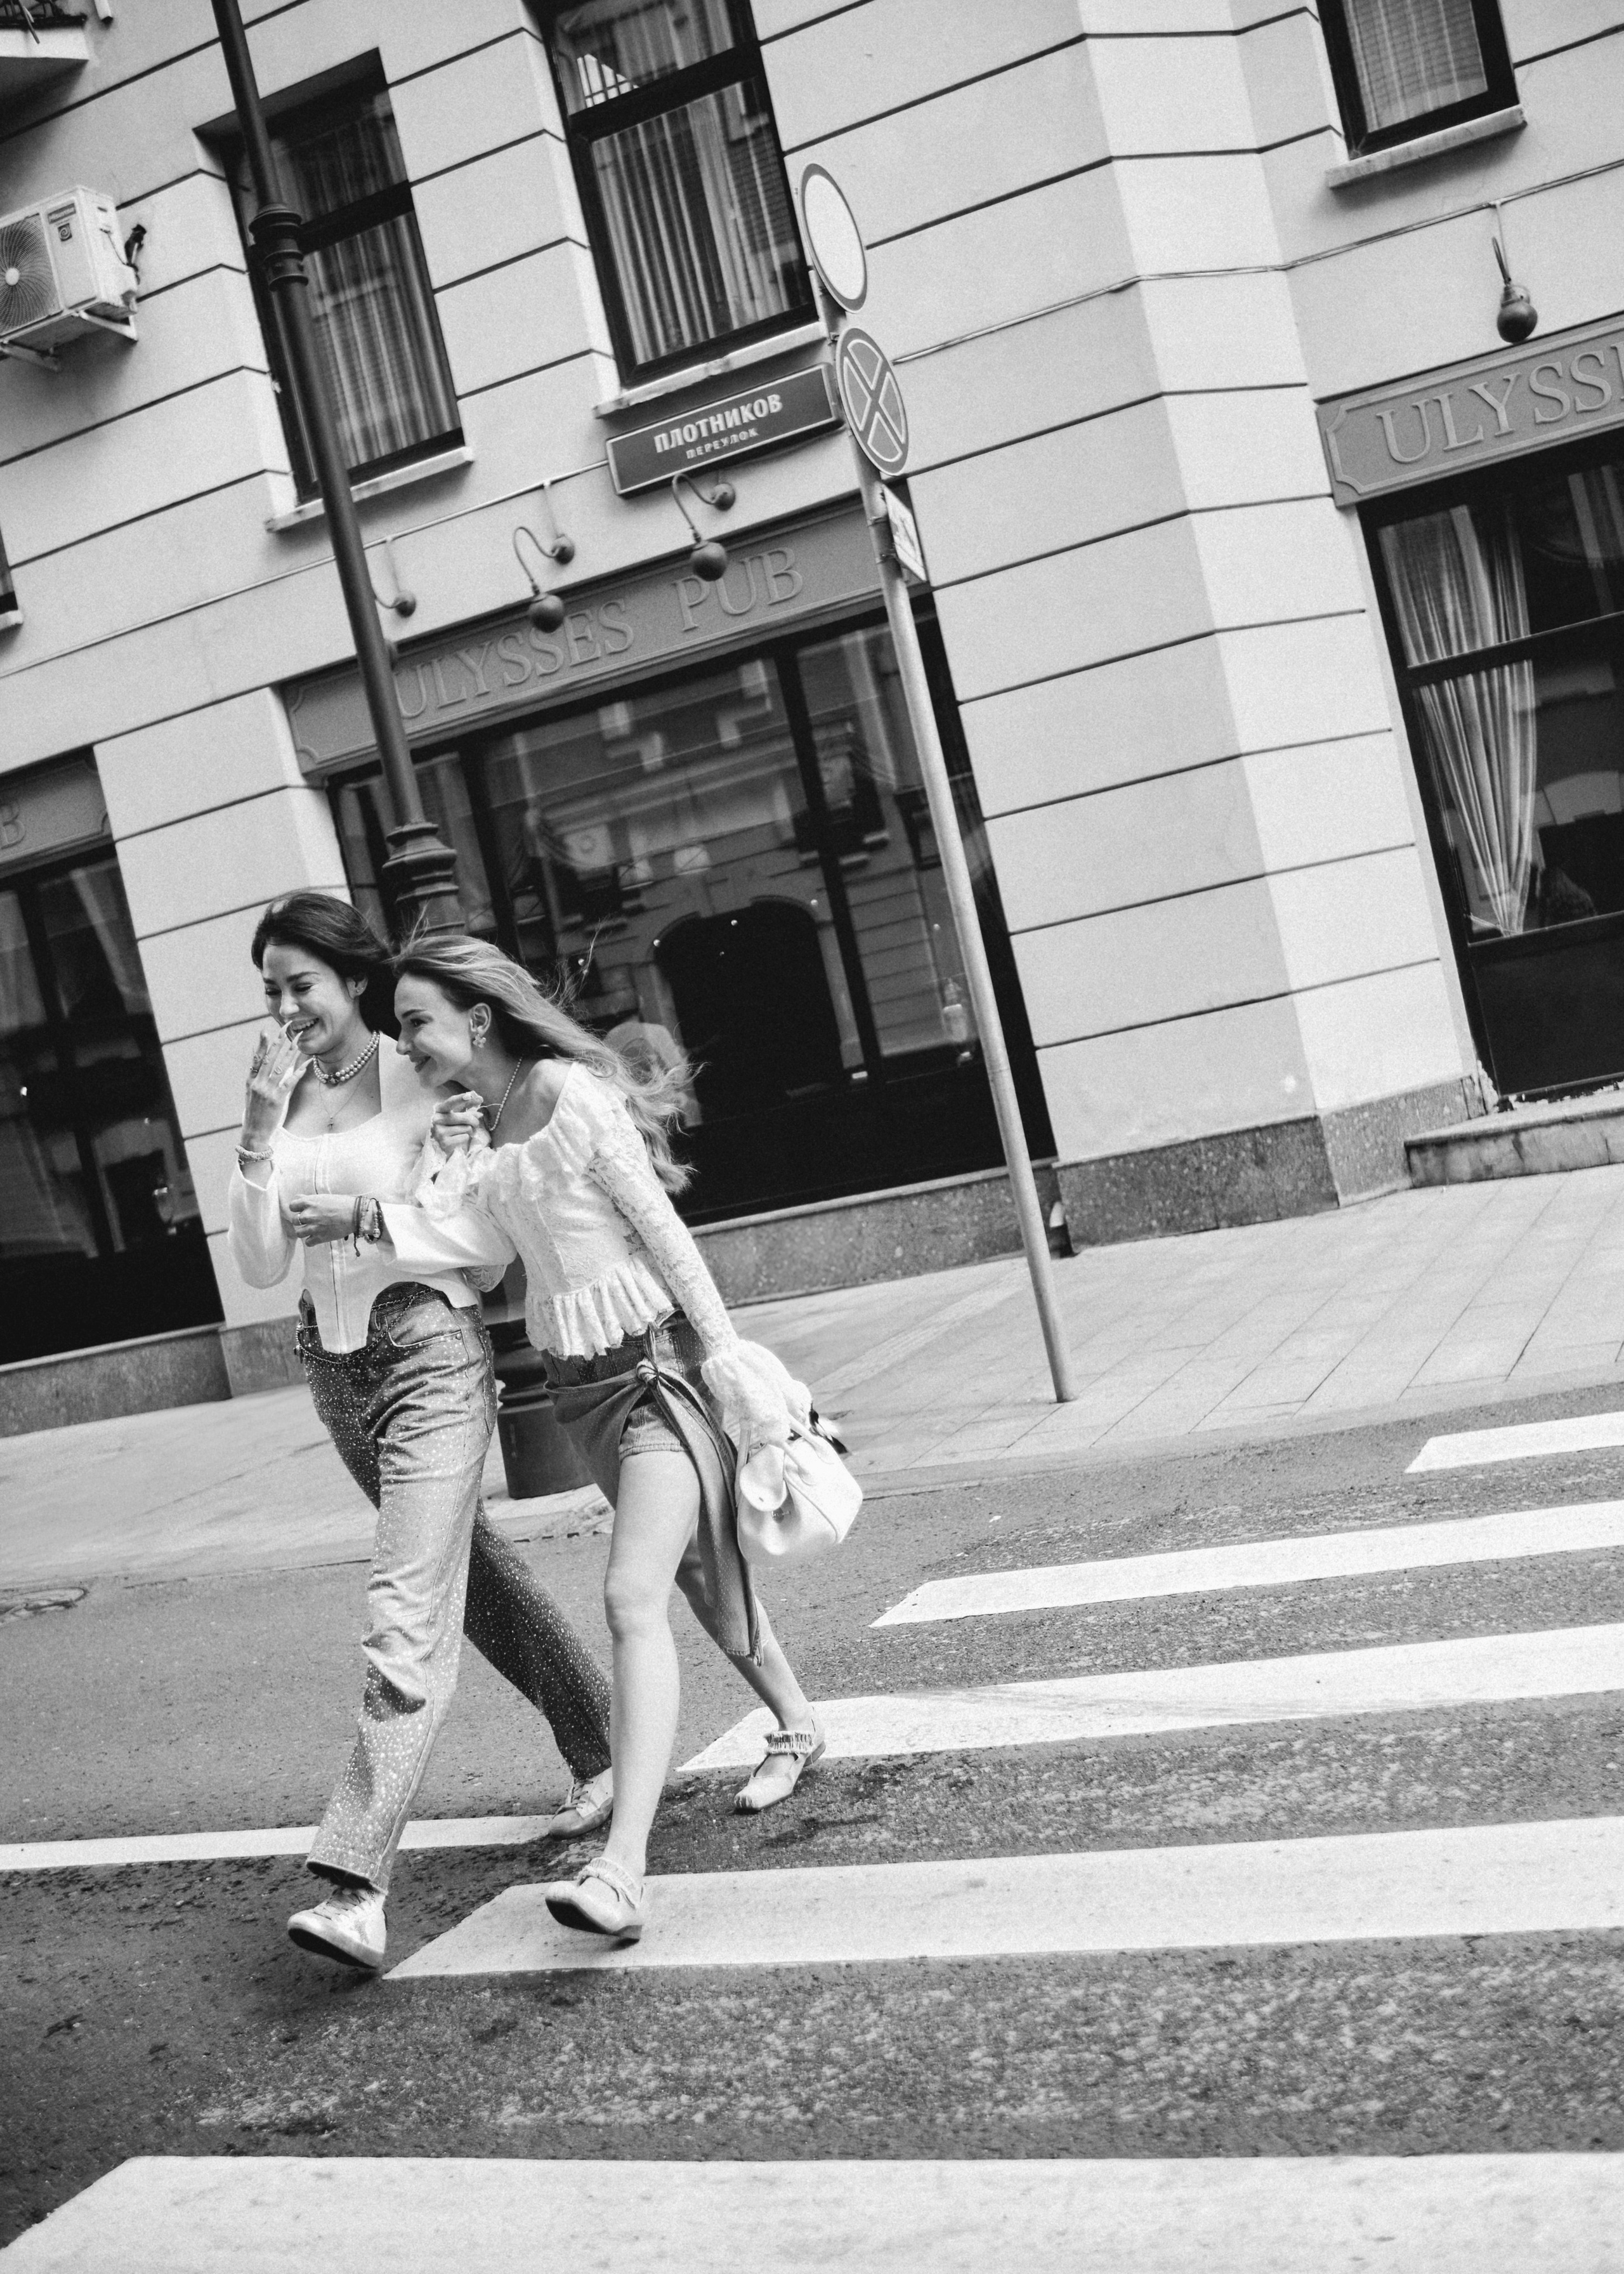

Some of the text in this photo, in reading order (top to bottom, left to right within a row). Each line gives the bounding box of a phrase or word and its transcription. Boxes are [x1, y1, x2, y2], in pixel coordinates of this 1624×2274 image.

[653, 393, 783, 454] ПЛОТНИКОВ
[685, 427, 759, 459] ПЕРЕУЛОК
[393, 547, 803, 718] ULYSSES PUB
